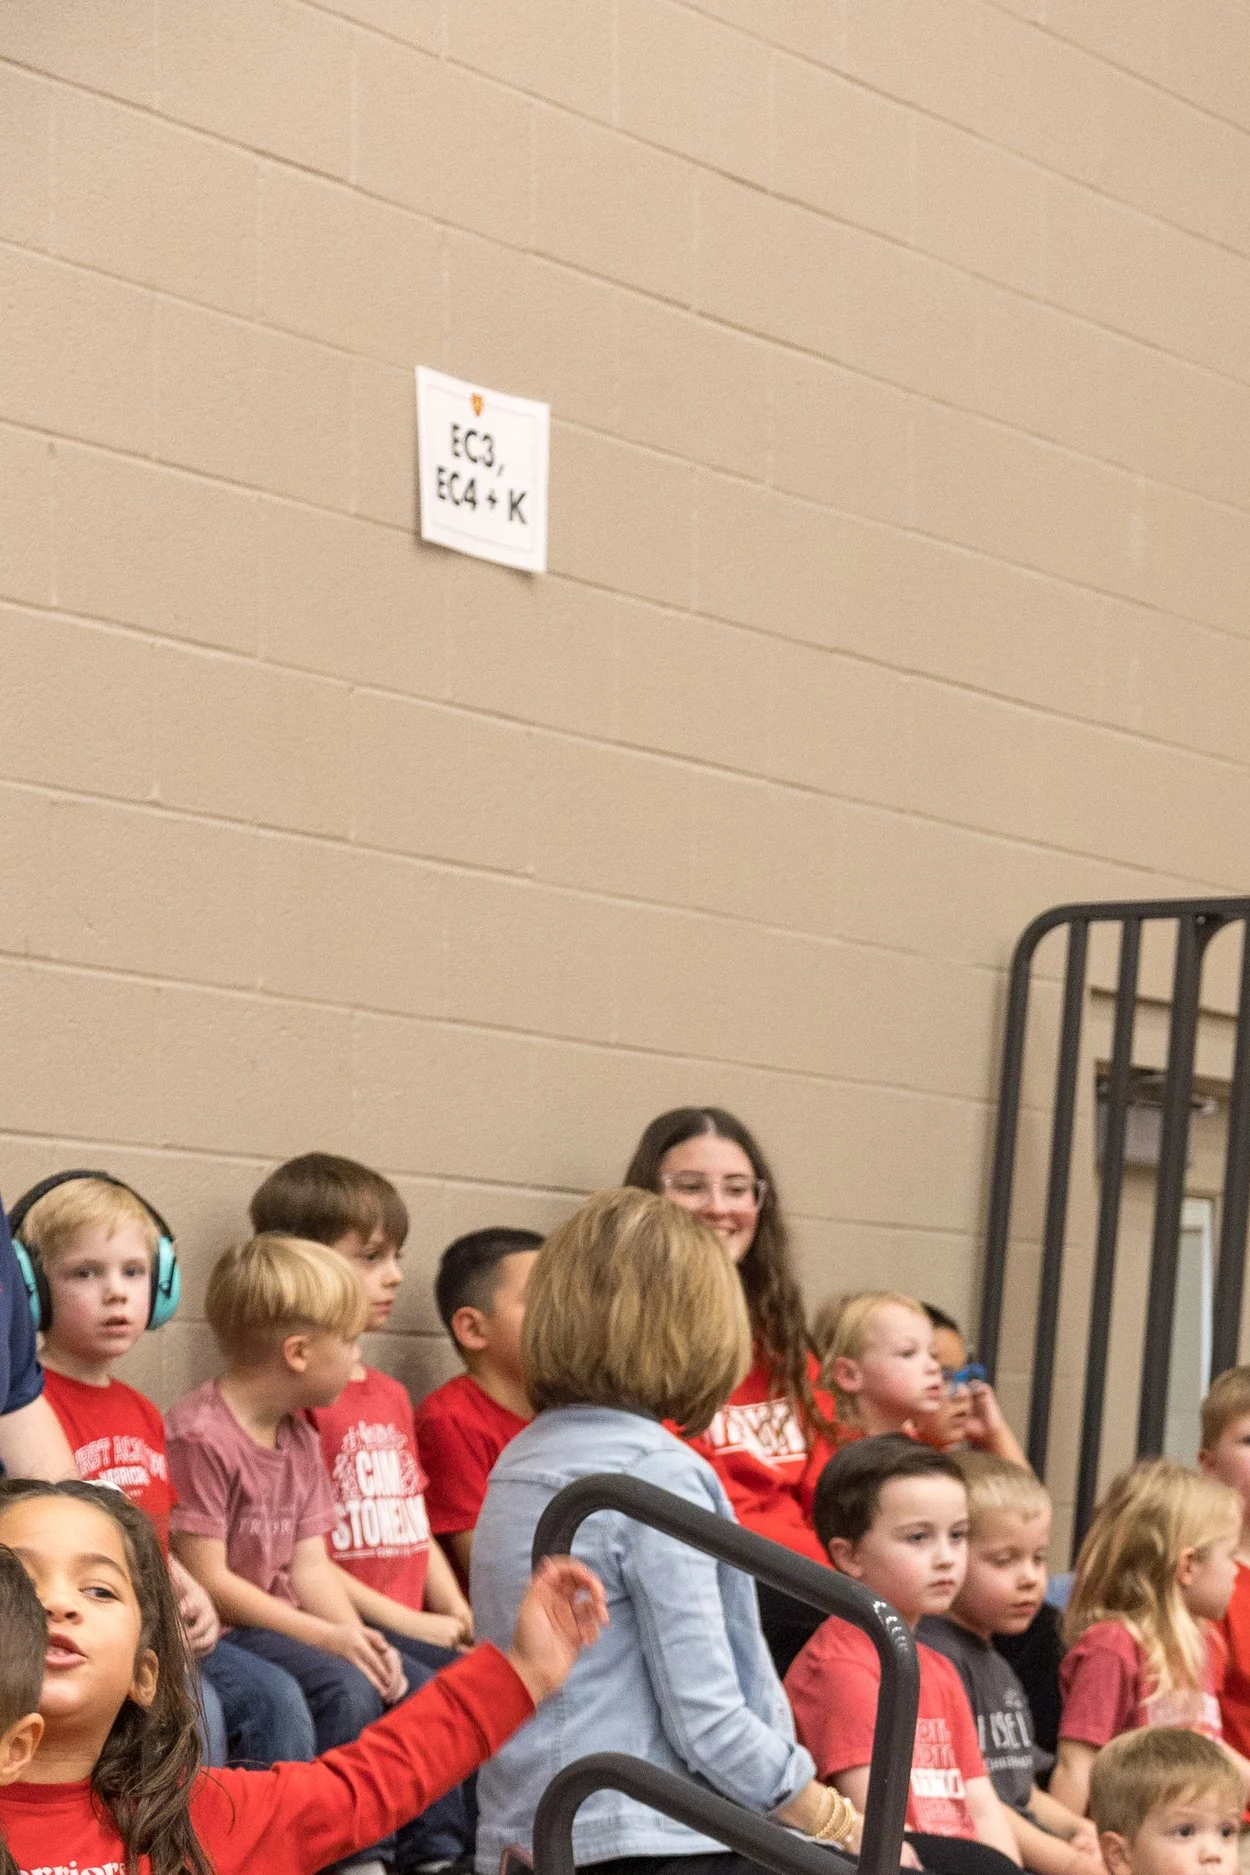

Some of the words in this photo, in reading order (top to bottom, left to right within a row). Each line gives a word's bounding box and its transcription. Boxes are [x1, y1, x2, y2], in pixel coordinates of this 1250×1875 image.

[451, 421, 505, 477] EC3,
[436, 465, 477, 513] EC4
[508, 487, 528, 525] K
